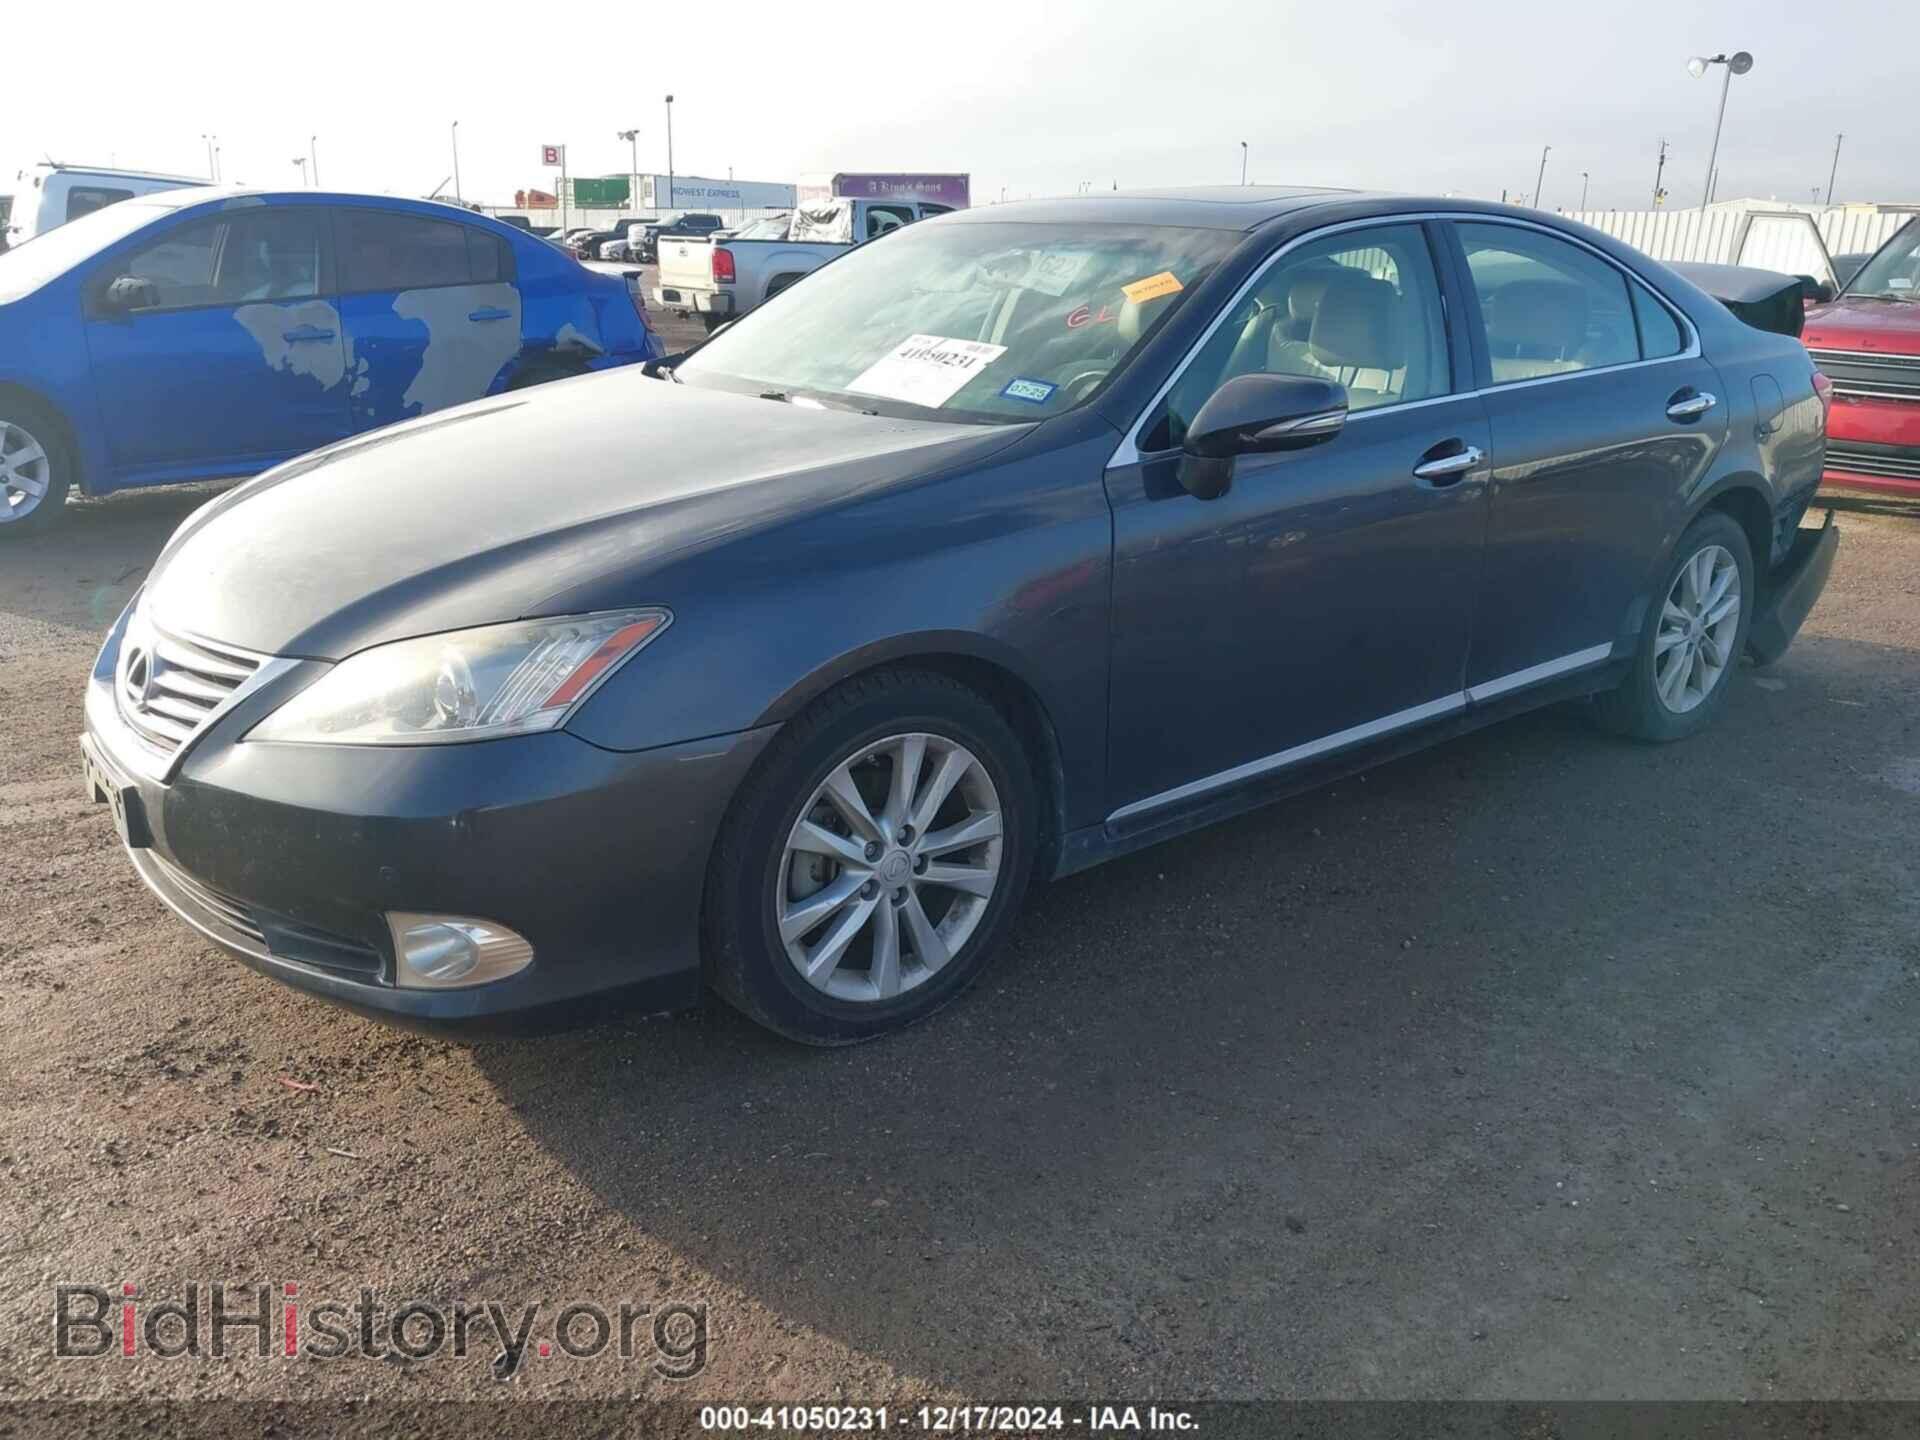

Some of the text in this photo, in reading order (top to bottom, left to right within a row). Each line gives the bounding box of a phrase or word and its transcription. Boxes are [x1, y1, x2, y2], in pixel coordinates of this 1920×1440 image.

[545, 147, 558, 163] B
[707, 189, 741, 199] EXPRESS
[899, 347, 977, 369] 41050231
